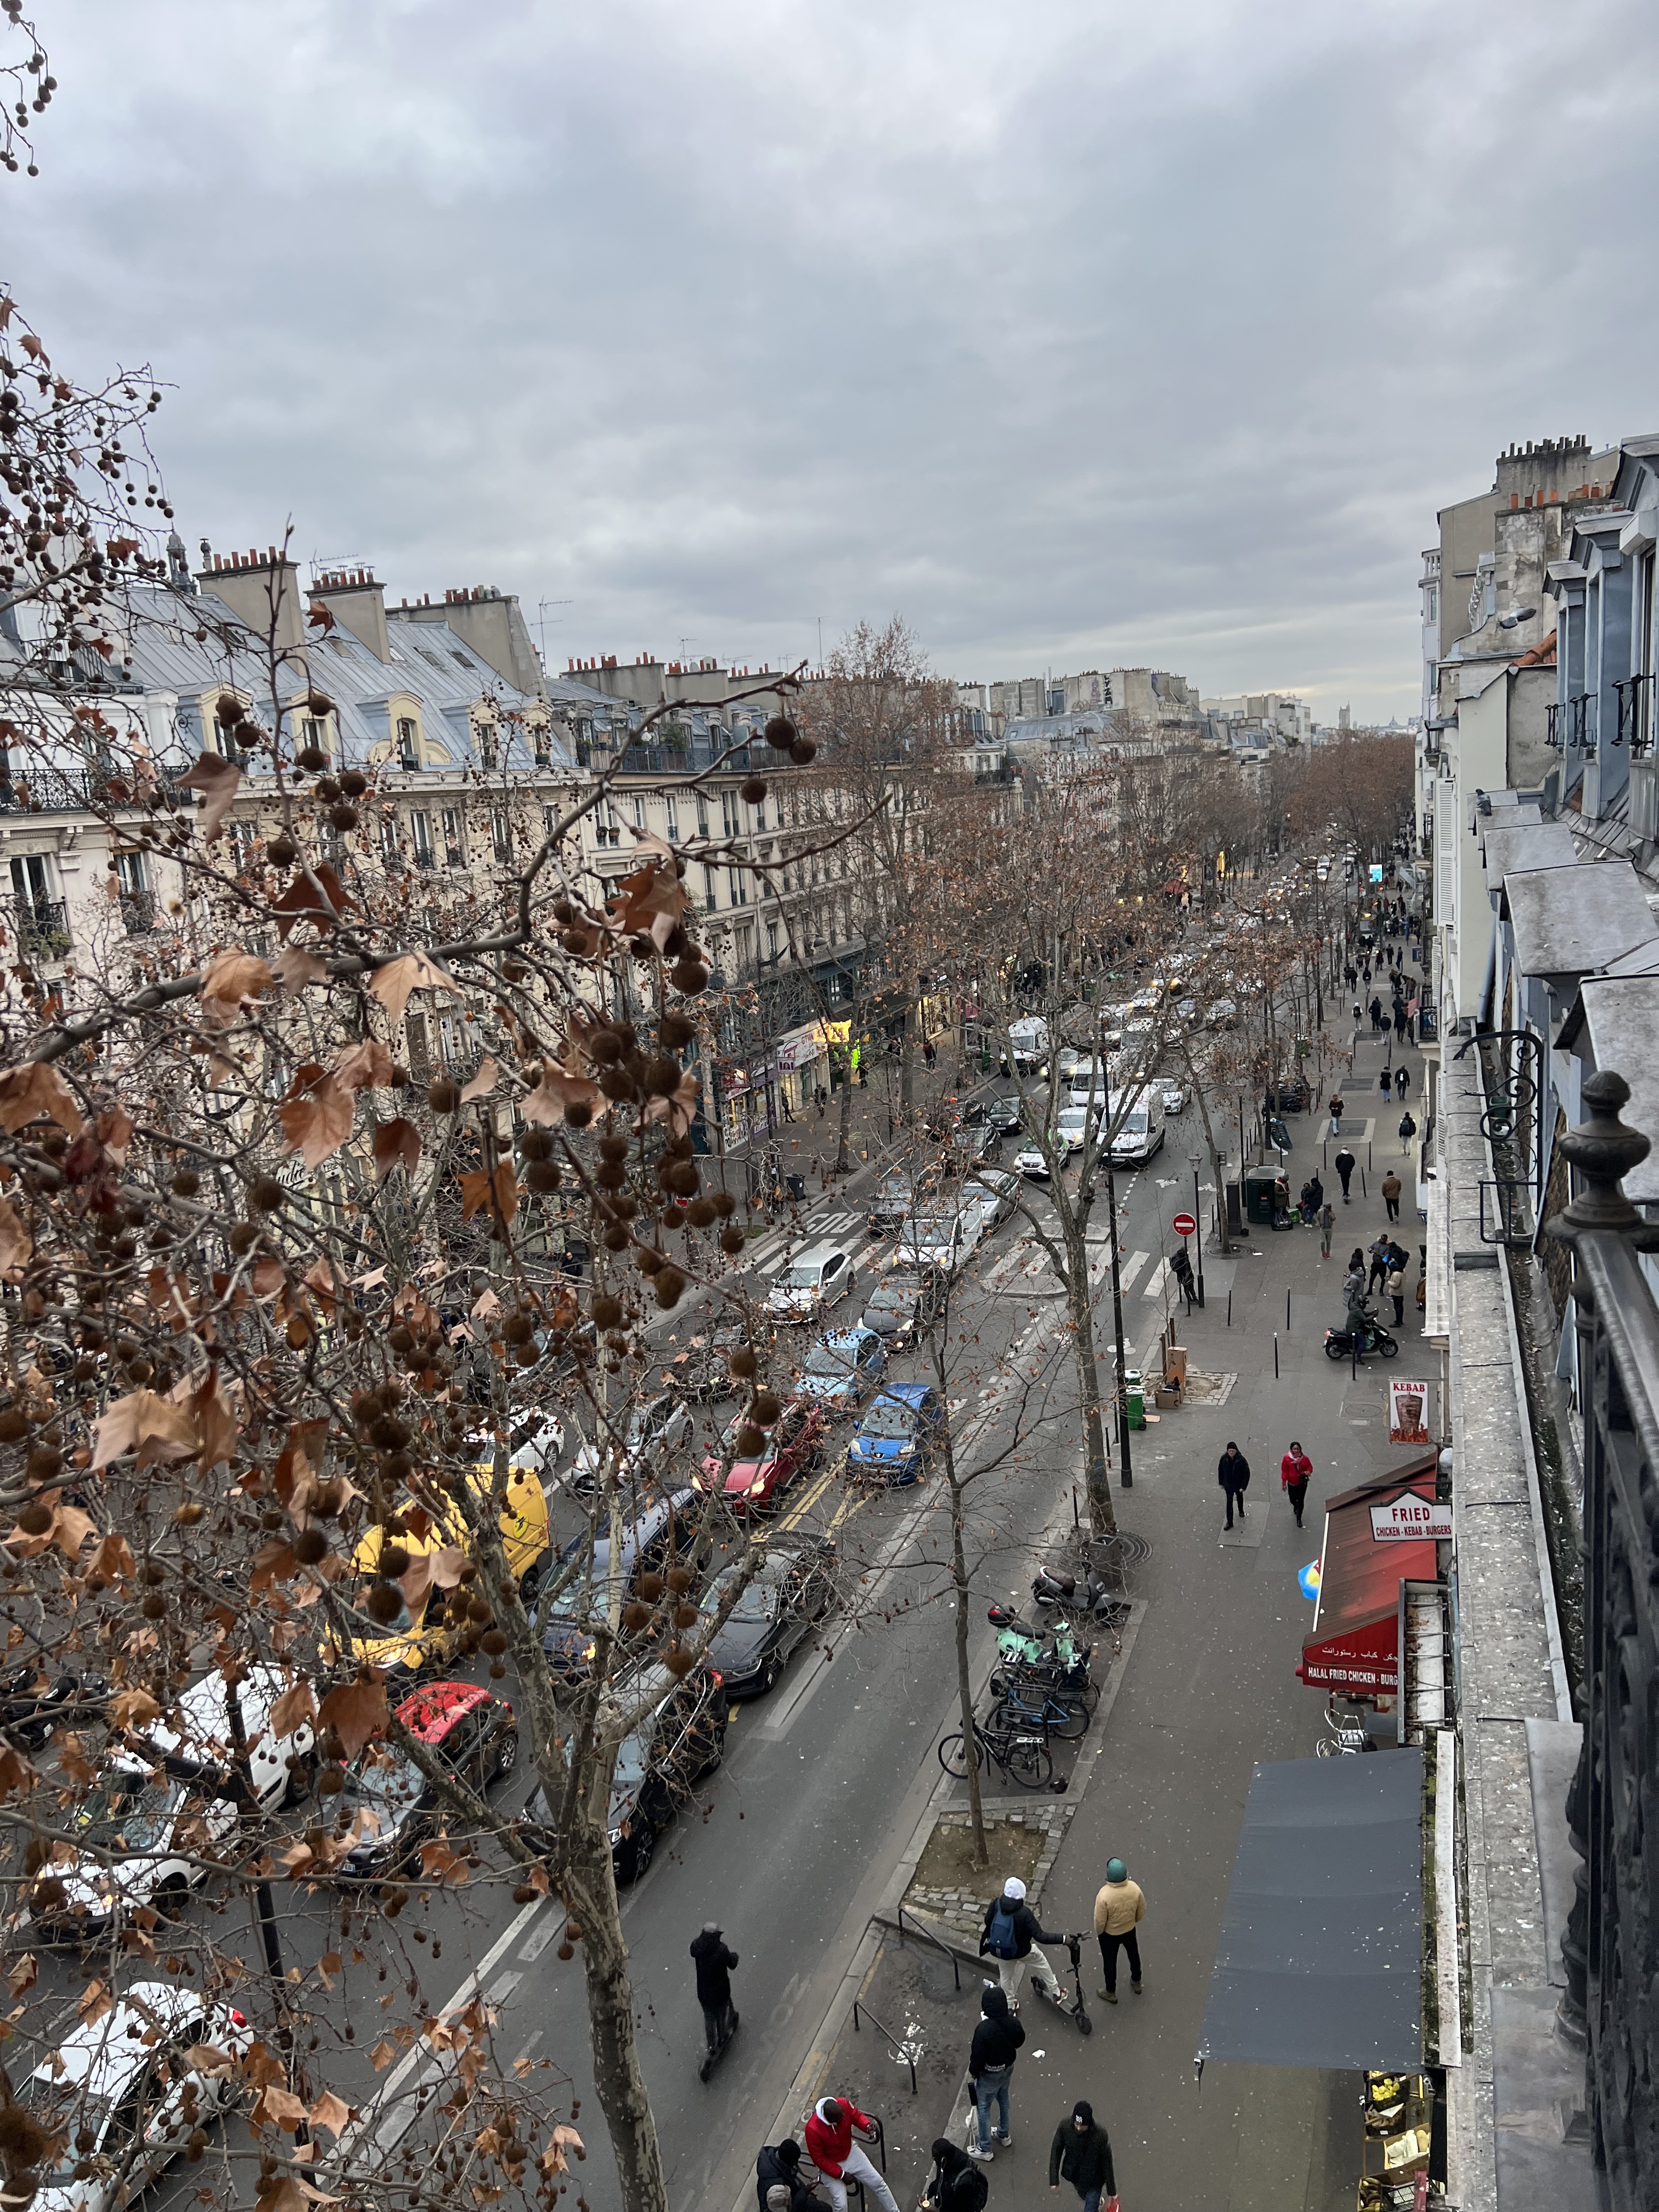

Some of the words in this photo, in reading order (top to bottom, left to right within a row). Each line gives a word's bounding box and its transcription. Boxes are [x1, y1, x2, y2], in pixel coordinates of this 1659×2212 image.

[1393, 1383, 1425, 1392] KEBAB
[1392, 1507, 1430, 1521] FRIED
[1376, 1526, 1400, 1537] CHICKEN
[1403, 1526, 1423, 1536] KEBAB
[1425, 1525, 1452, 1535] BURGERS
[1308, 1667, 1328, 1679] HALAL
[1329, 1669, 1347, 1680] FRIED
[1348, 1671, 1376, 1684] CHICKEN
[1380, 1673, 1398, 1685] BURG
